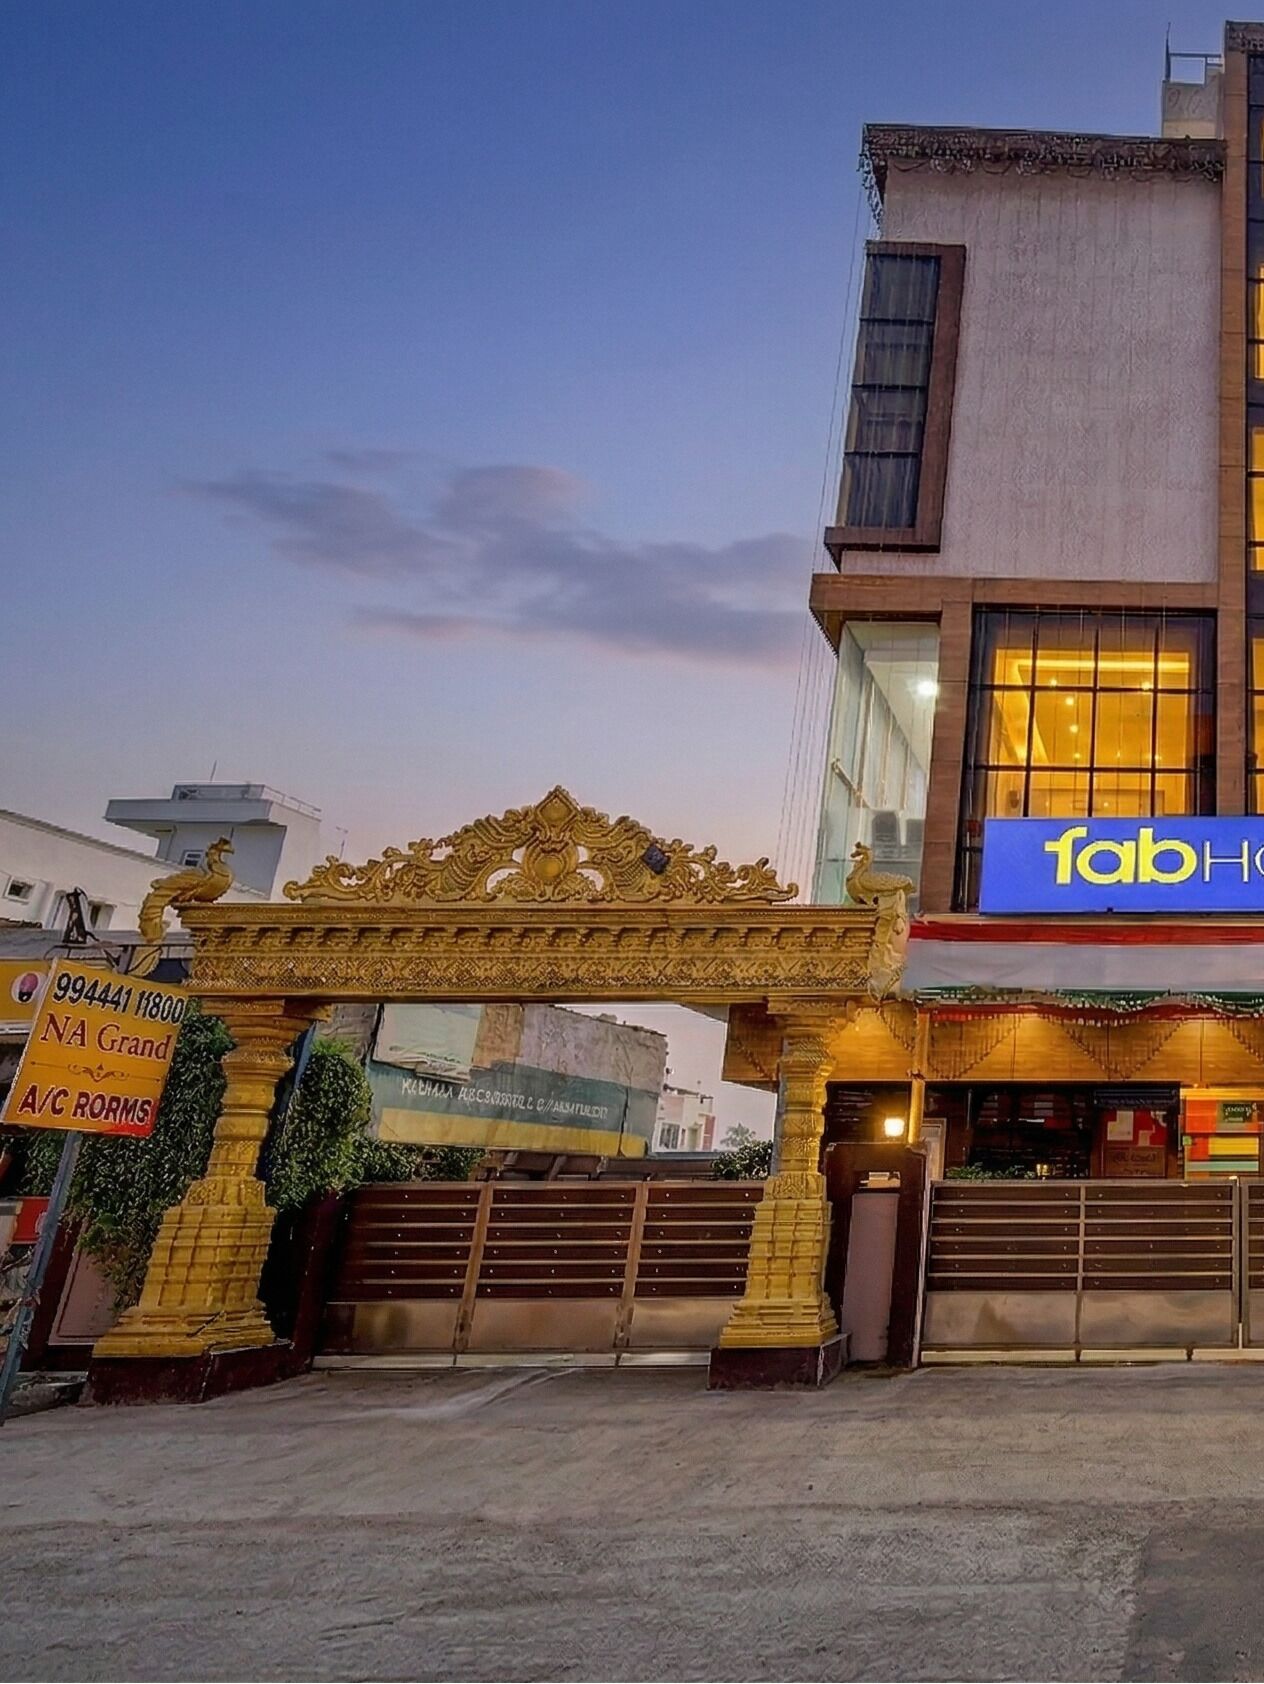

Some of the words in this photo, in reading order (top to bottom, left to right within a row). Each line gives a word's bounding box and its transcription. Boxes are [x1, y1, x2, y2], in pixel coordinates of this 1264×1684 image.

[53, 972, 132, 1013] 994441
[134, 989, 184, 1024] 11800
[40, 1012, 87, 1047] NA
[97, 1023, 173, 1060] Grand
[18, 1084, 69, 1115] A/C
